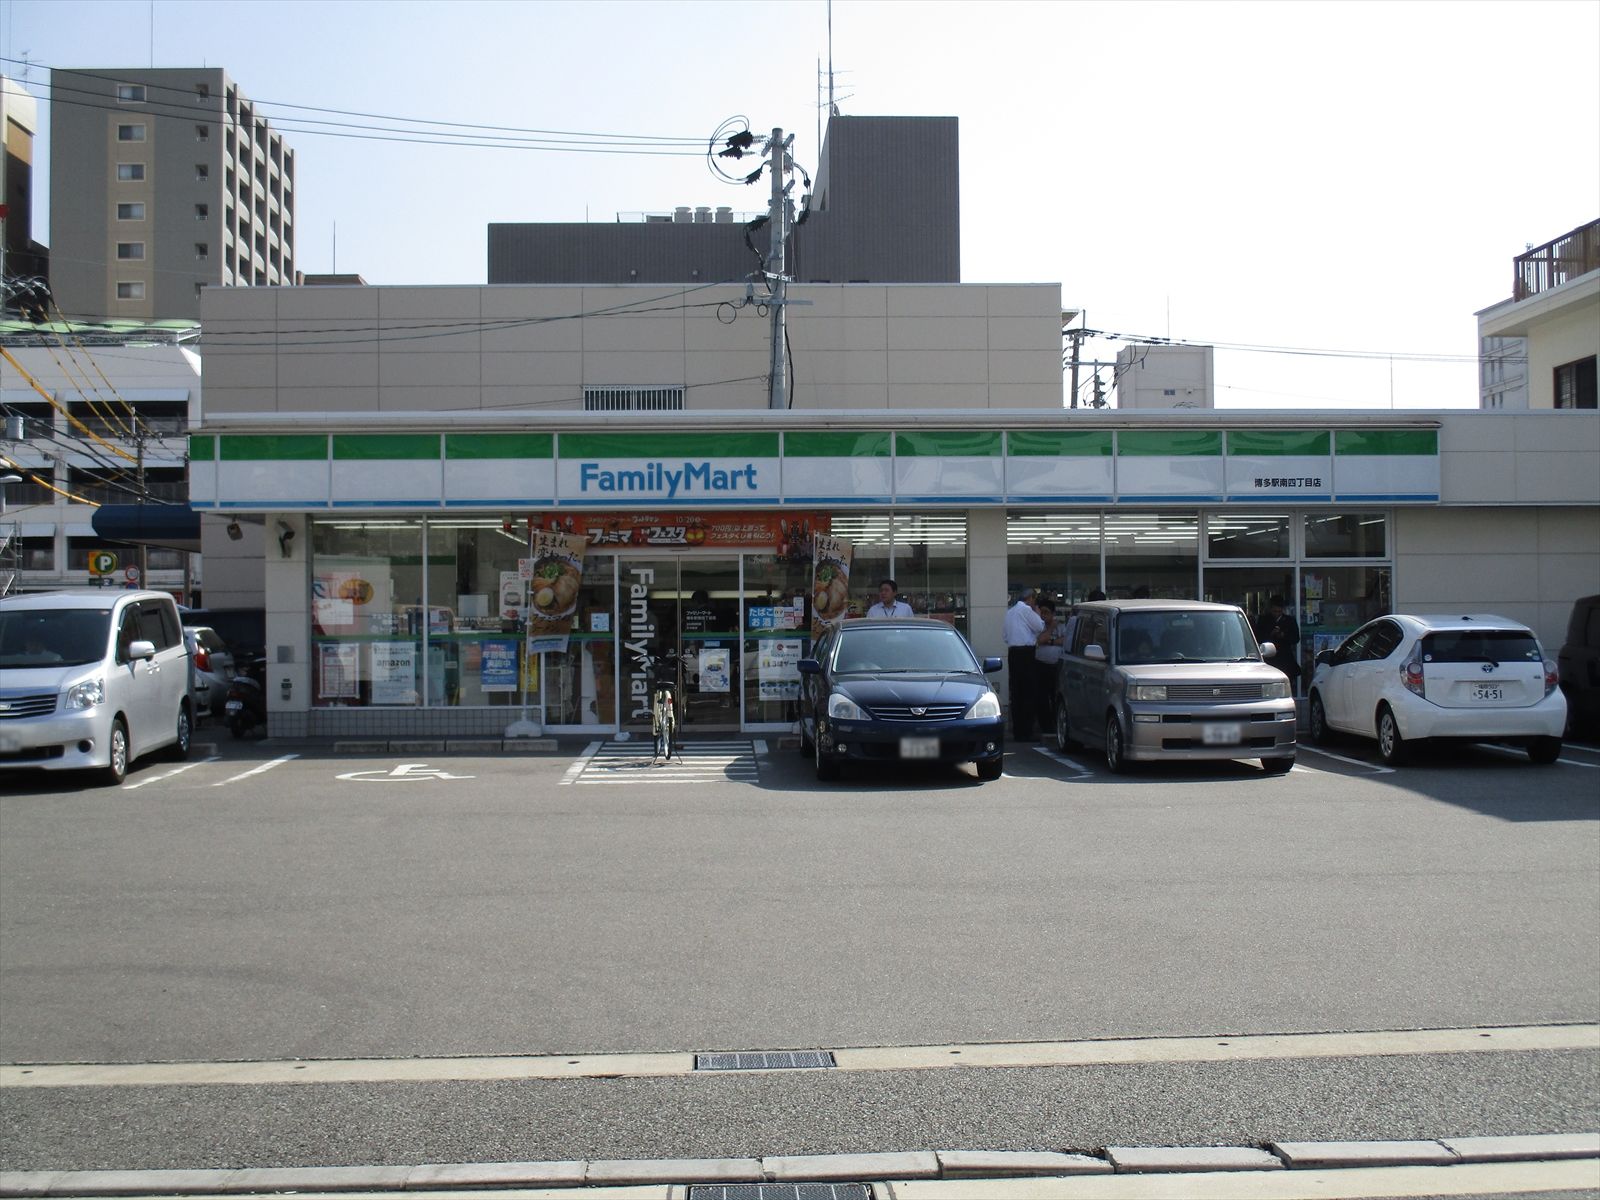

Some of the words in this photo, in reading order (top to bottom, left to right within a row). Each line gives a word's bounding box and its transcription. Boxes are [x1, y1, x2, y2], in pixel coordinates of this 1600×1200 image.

[580, 462, 757, 499] FamilyMart
[1254, 478, 1322, 488] 博多駅南四丁目店
[587, 528, 632, 544] ファミマ
[650, 526, 687, 539] フェスタ
[100, 555, 112, 571] P
[749, 607, 774, 617] たばこ
[377, 659, 411, 667] amazon
[1478, 689, 1503, 699] 54-51
